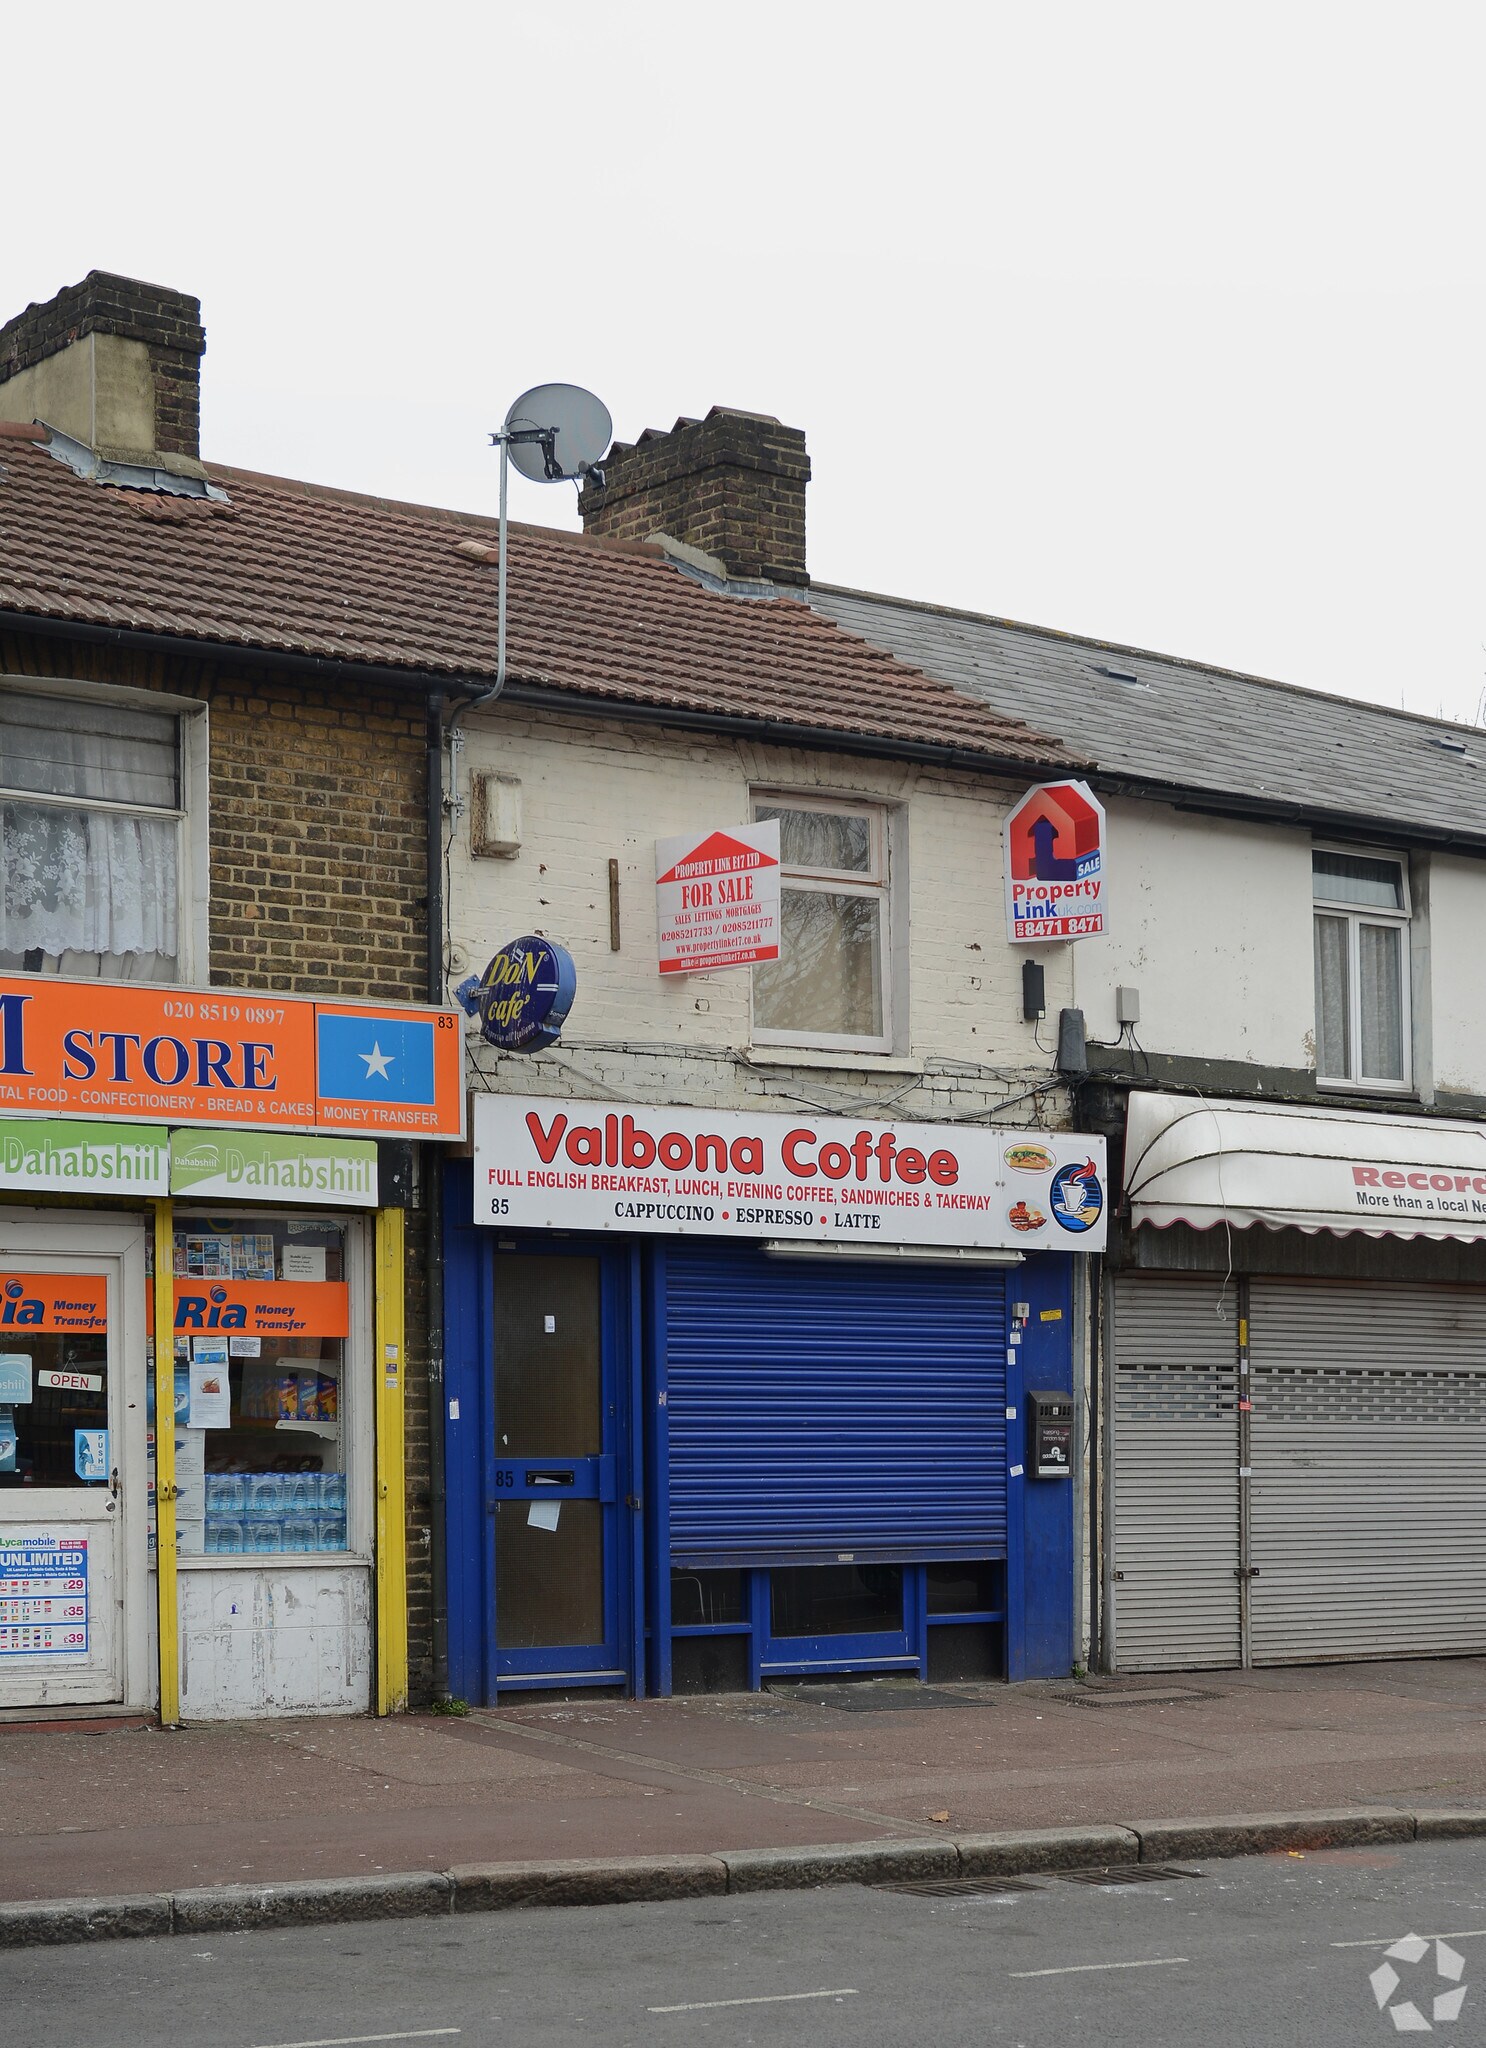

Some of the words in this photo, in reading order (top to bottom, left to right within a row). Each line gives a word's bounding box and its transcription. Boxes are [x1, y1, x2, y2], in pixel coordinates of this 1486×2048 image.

[675, 860, 712, 879] PROPERTY
[715, 857, 730, 874] LINK
[733, 855, 745, 870] E17
[747, 852, 760, 868] LTD
[1078, 857, 1100, 877] SALE
[682, 882, 713, 909] FOR
[718, 876, 753, 904] SALE
[1013, 879, 1101, 903] Property
[675, 914, 691, 925] SALES
[694, 909, 722, 923] LETTINGS
[726, 904, 762, 919] MORTGAGES
[662, 926, 713, 942] 02085217733
[722, 917, 773, 933] 02085211777
[1025, 919, 1062, 937] 8471
[1068, 916, 1102, 933] 8471
[676, 933, 762, 954] www.propertylinke17.co.uk
[163, 1000, 194, 1019] 020
[200, 1003, 240, 1022] 8519
[245, 1007, 285, 1025] 0897
[438, 1016, 454, 1030] 83
[62, 1029, 278, 1090] STORE
[28, 1087, 68, 1102] FOOD
[80, 1090, 196, 1109] CONFECTIONERY
[207, 1098, 254, 1113] BREAD
[257, 1101, 267, 1114] &
[269, 1102, 314, 1117] CAKES
[323, 1106, 369, 1121] MONEY
[372, 1109, 438, 1126] TRANSFER
[4, 1137, 160, 1181] Dahabshiil
[525, 1111, 763, 1176] Valbona
[781, 1128, 960, 1187] Coffee
[225, 1148, 370, 1193] Dahabshiil
[488, 1168, 523, 1187] FULL
[527, 1170, 587, 1190] ENGLISH
[591, 1174, 671, 1198] BREAKFAST,
[675, 1178, 723, 1200] LUNCH,
[727, 1181, 783, 1201] EVENING
[786, 1186, 837, 1206] COFFEE,
[841, 1188, 920, 1208] SANDWICHES
[924, 1192, 932, 1208] &
[936, 1192, 991, 1211] TAKEWAY
[491, 1198, 509, 1215] 85
[1356, 1192, 1390, 1207] More
[1393, 1194, 1423, 1209] than
[1427, 1200, 1435, 1210] a
[1437, 1197, 1469, 1212] local
[614, 1201, 715, 1222] CAPPUCCINO
[735, 1207, 814, 1226] ESPRESSO
[834, 1212, 881, 1230] LATTE
[0, 1279, 45, 1325] ia
[53, 1300, 96, 1313] Money
[174, 1285, 247, 1329] Ria
[255, 1305, 295, 1317] Money
[53, 1316, 107, 1327] Transfer
[255, 1320, 306, 1332] Transfer
[50, 1374, 89, 1389] OPEN
[495, 1471, 514, 1488] 85
[0, 1537, 55, 1547] Lycamobile
[0, 1552, 83, 1566] UNLIMITED
[63, 1580, 83, 1589] £29
[63, 1606, 84, 1616] £35
[63, 1633, 84, 1643] £39
